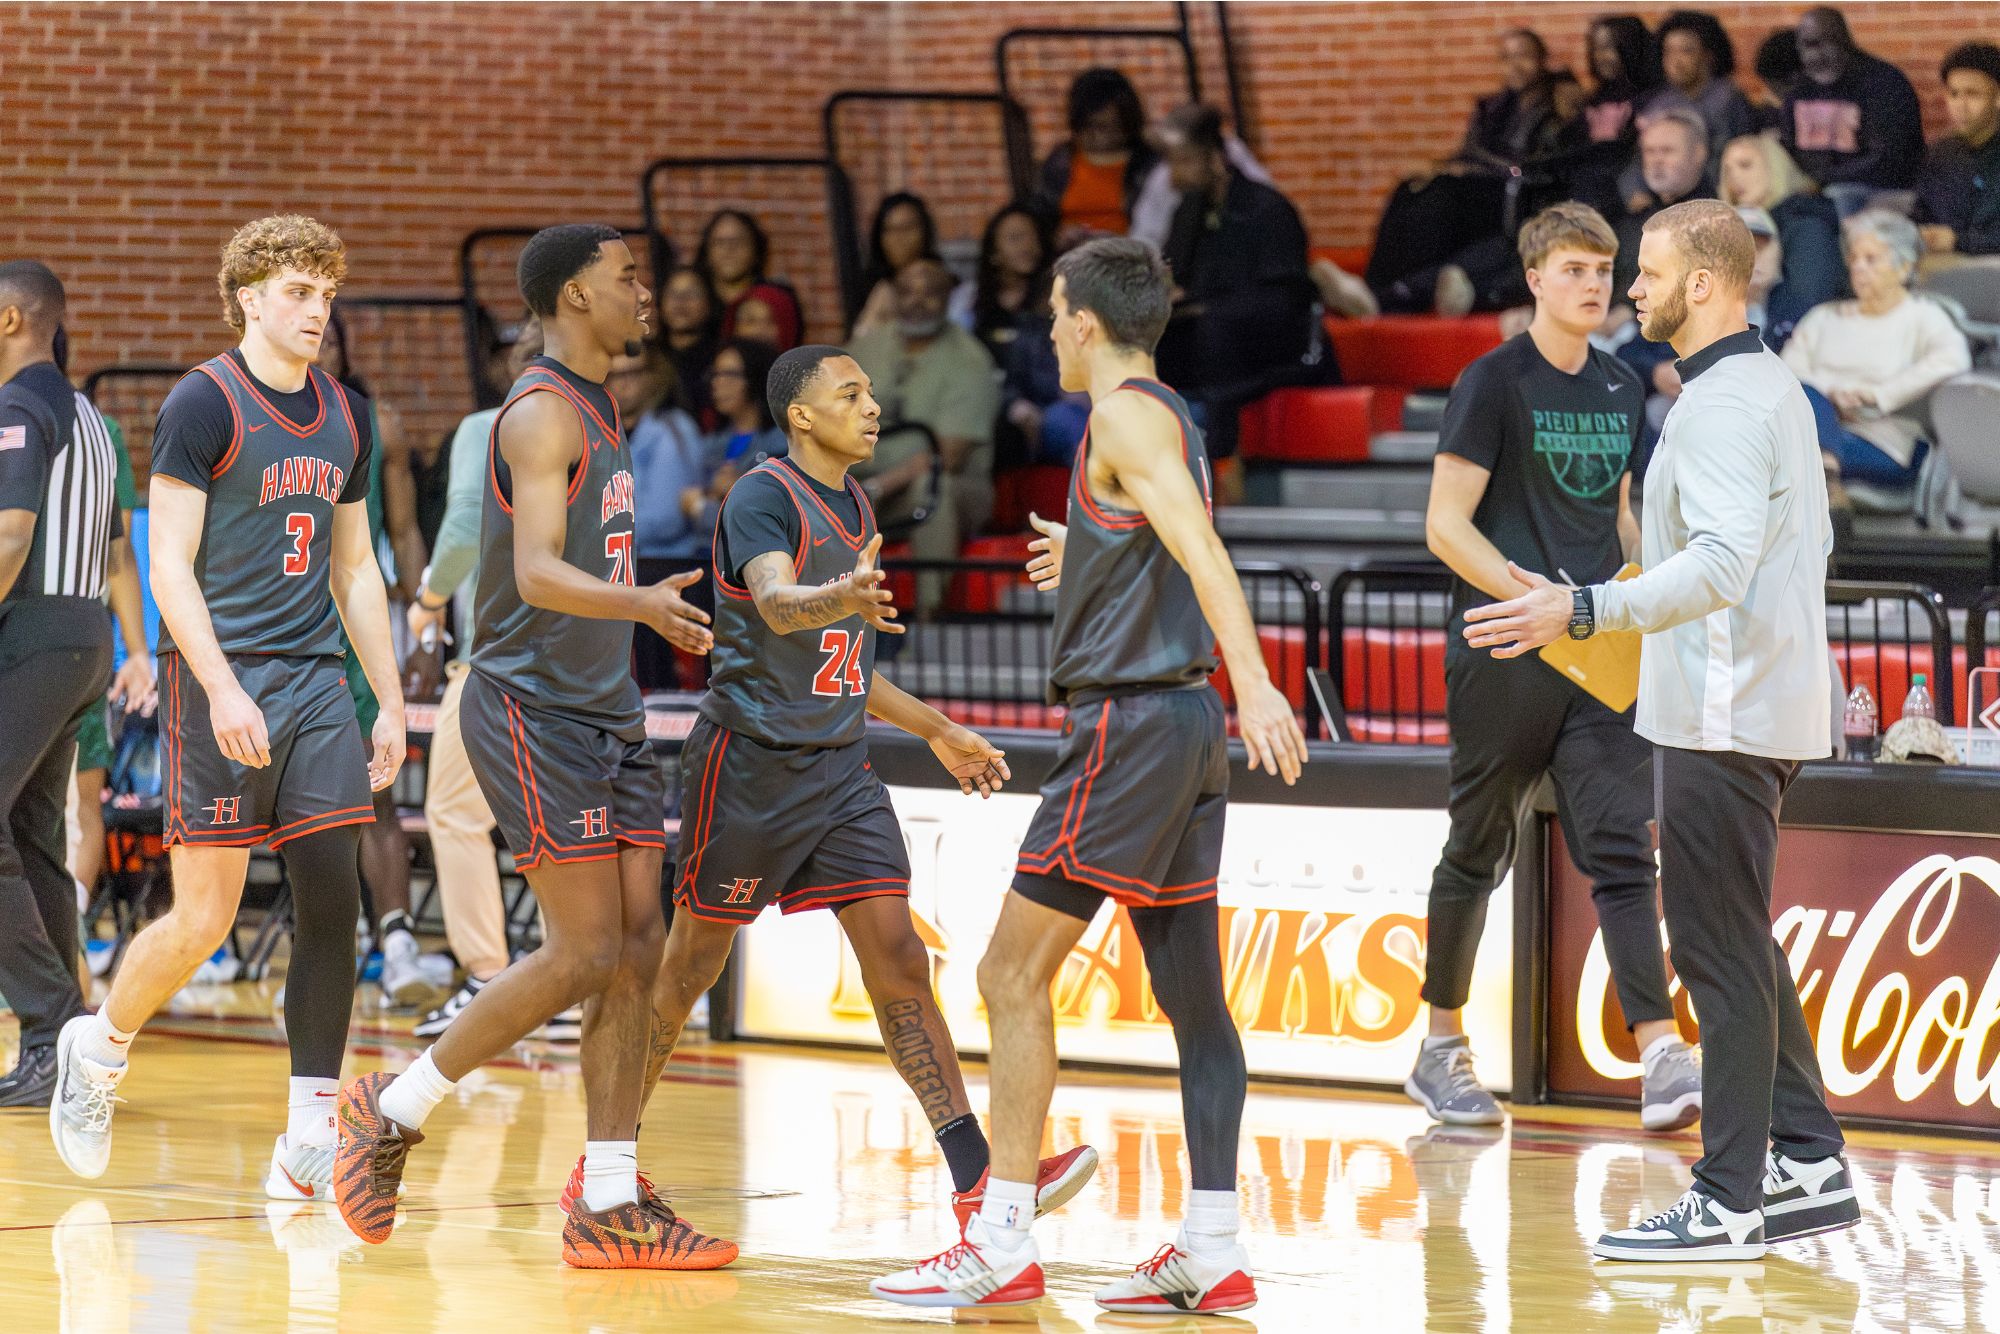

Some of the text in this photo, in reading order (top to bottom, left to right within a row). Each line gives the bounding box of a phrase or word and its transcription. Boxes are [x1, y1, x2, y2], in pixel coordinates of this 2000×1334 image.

[258, 456, 344, 506] HAWKS
[284, 512, 315, 576] 3
[811, 629, 866, 697] 24
